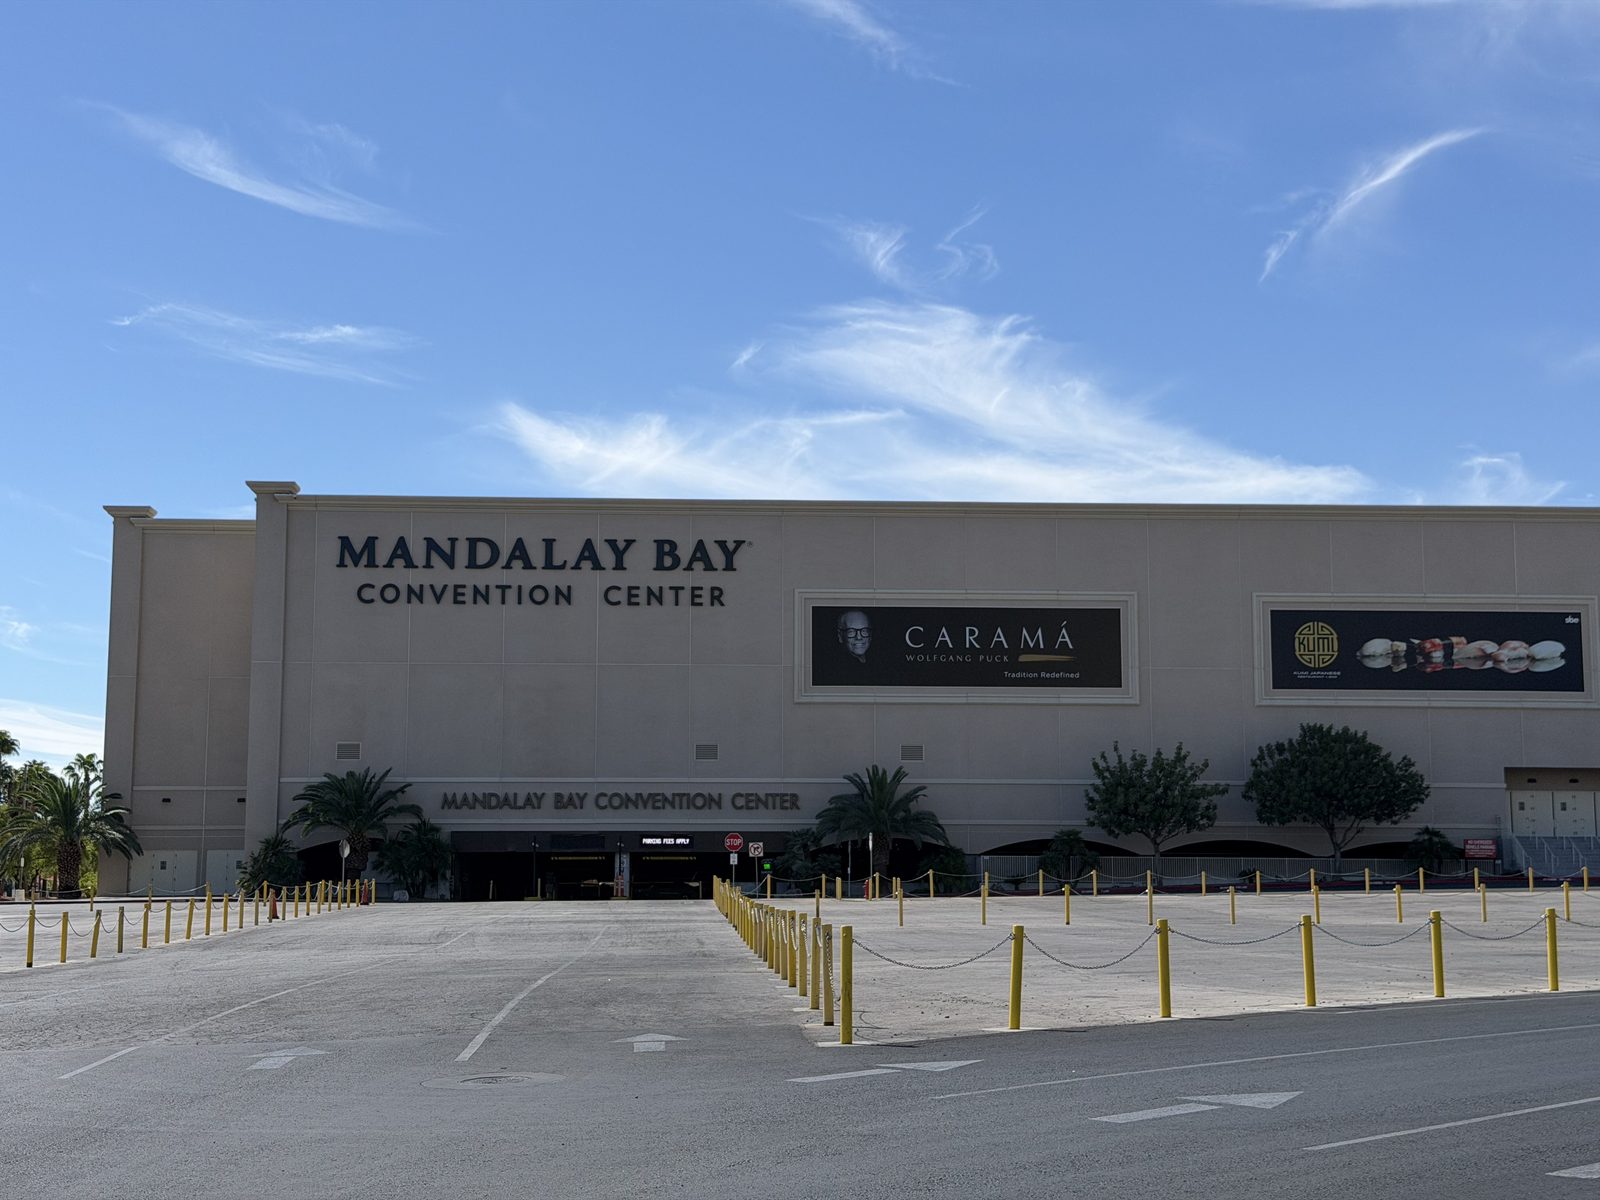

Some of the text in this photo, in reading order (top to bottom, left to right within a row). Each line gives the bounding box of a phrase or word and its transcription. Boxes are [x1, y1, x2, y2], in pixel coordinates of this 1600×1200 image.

[336, 535, 746, 572] MANDALAY BAY
[356, 583, 726, 607] CONVENTION CENTER
[905, 620, 1073, 649] CARAMÁ
[905, 654, 1009, 663] WOLFGANG PUCK
[1040, 671, 1080, 679] Redefined
[441, 792, 800, 811] MANDALAY BAY CONVENTION CENTER
[726, 838, 742, 846] STOP
